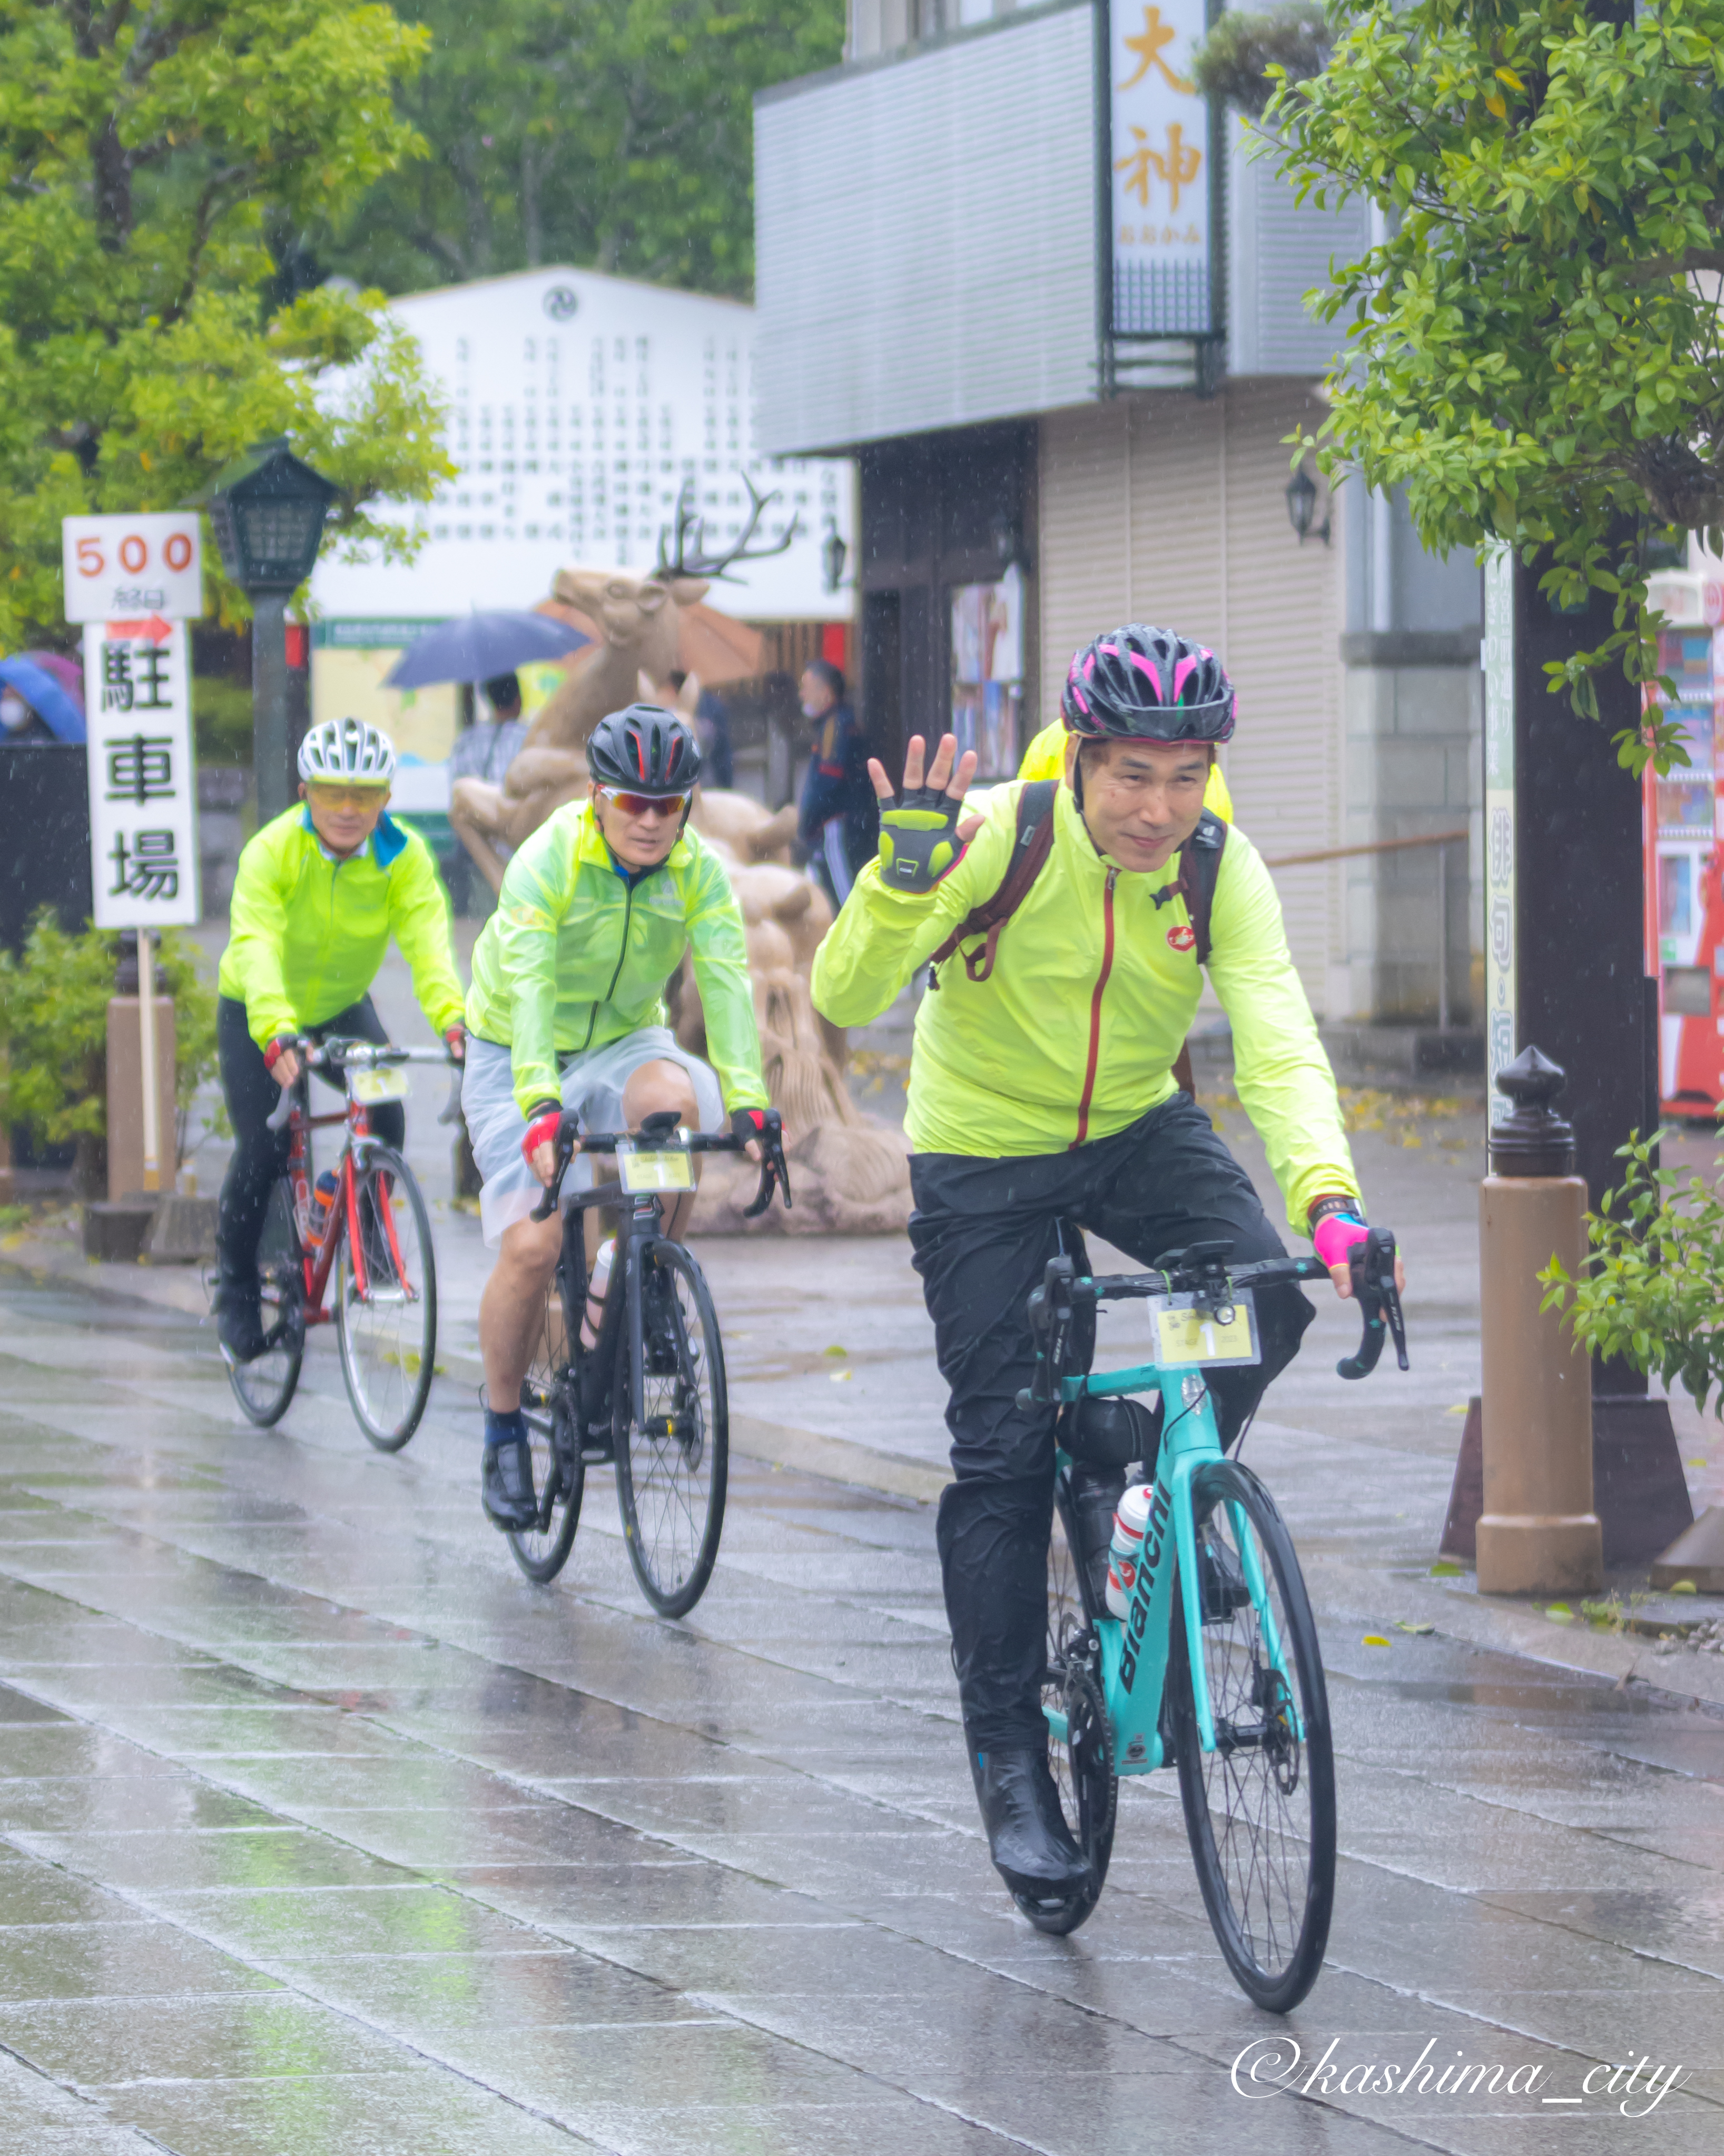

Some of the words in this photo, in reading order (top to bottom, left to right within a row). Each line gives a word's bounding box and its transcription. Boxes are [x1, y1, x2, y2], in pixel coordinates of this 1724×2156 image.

[1115, 4, 1201, 213] 大神
[75, 532, 193, 577] 500
[100, 640, 179, 901] 駐車場
[653, 1163, 665, 1187] 1
[1199, 1322, 1216, 1357] 1
[1119, 1479, 1172, 1695] Bianchi
